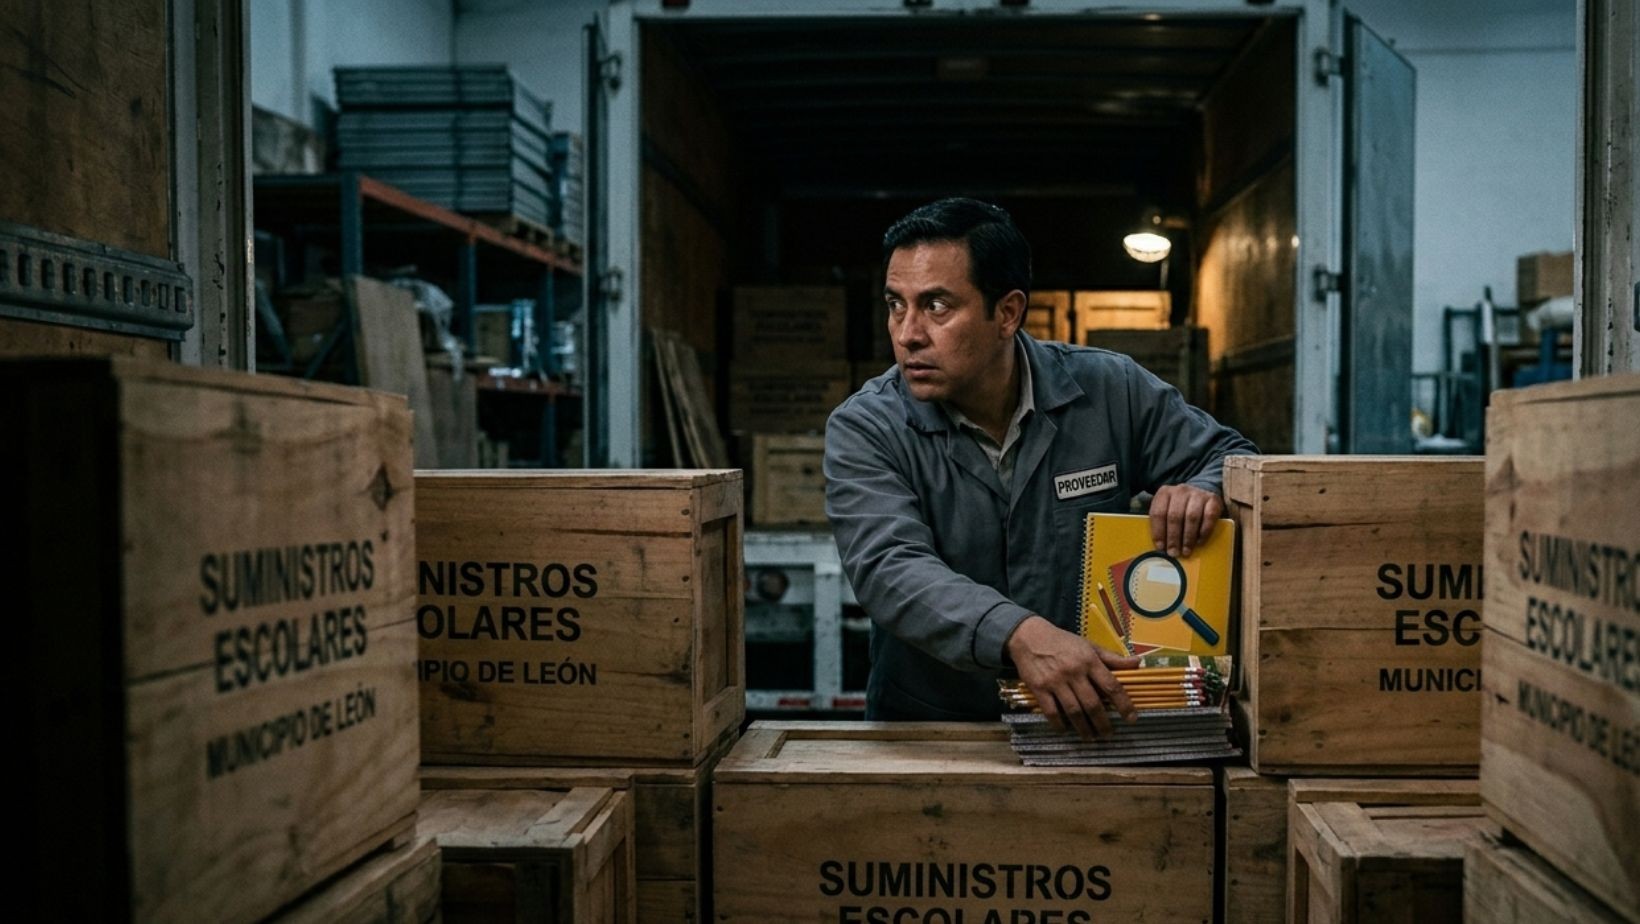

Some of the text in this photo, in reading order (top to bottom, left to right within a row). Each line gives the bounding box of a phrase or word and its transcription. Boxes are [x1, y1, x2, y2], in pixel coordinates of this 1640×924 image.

[1057, 470, 1117, 494] PROVEEDAR
[200, 540, 375, 616] SUMINISTROS
[419, 561, 598, 599] NISTROS
[1376, 563, 1484, 600] SUMI
[417, 604, 582, 642] OLARES
[1395, 609, 1482, 647] ESC
[214, 605, 368, 694] ESCOLARES
[1526, 596, 1640, 692] ESCOLARE
[478, 661, 514, 683] DE
[524, 656, 597, 685] LEÓN
[206, 682, 377, 781] MUNICIPIO DE LEÓN
[819, 860, 1112, 901] SUMINISTROS
